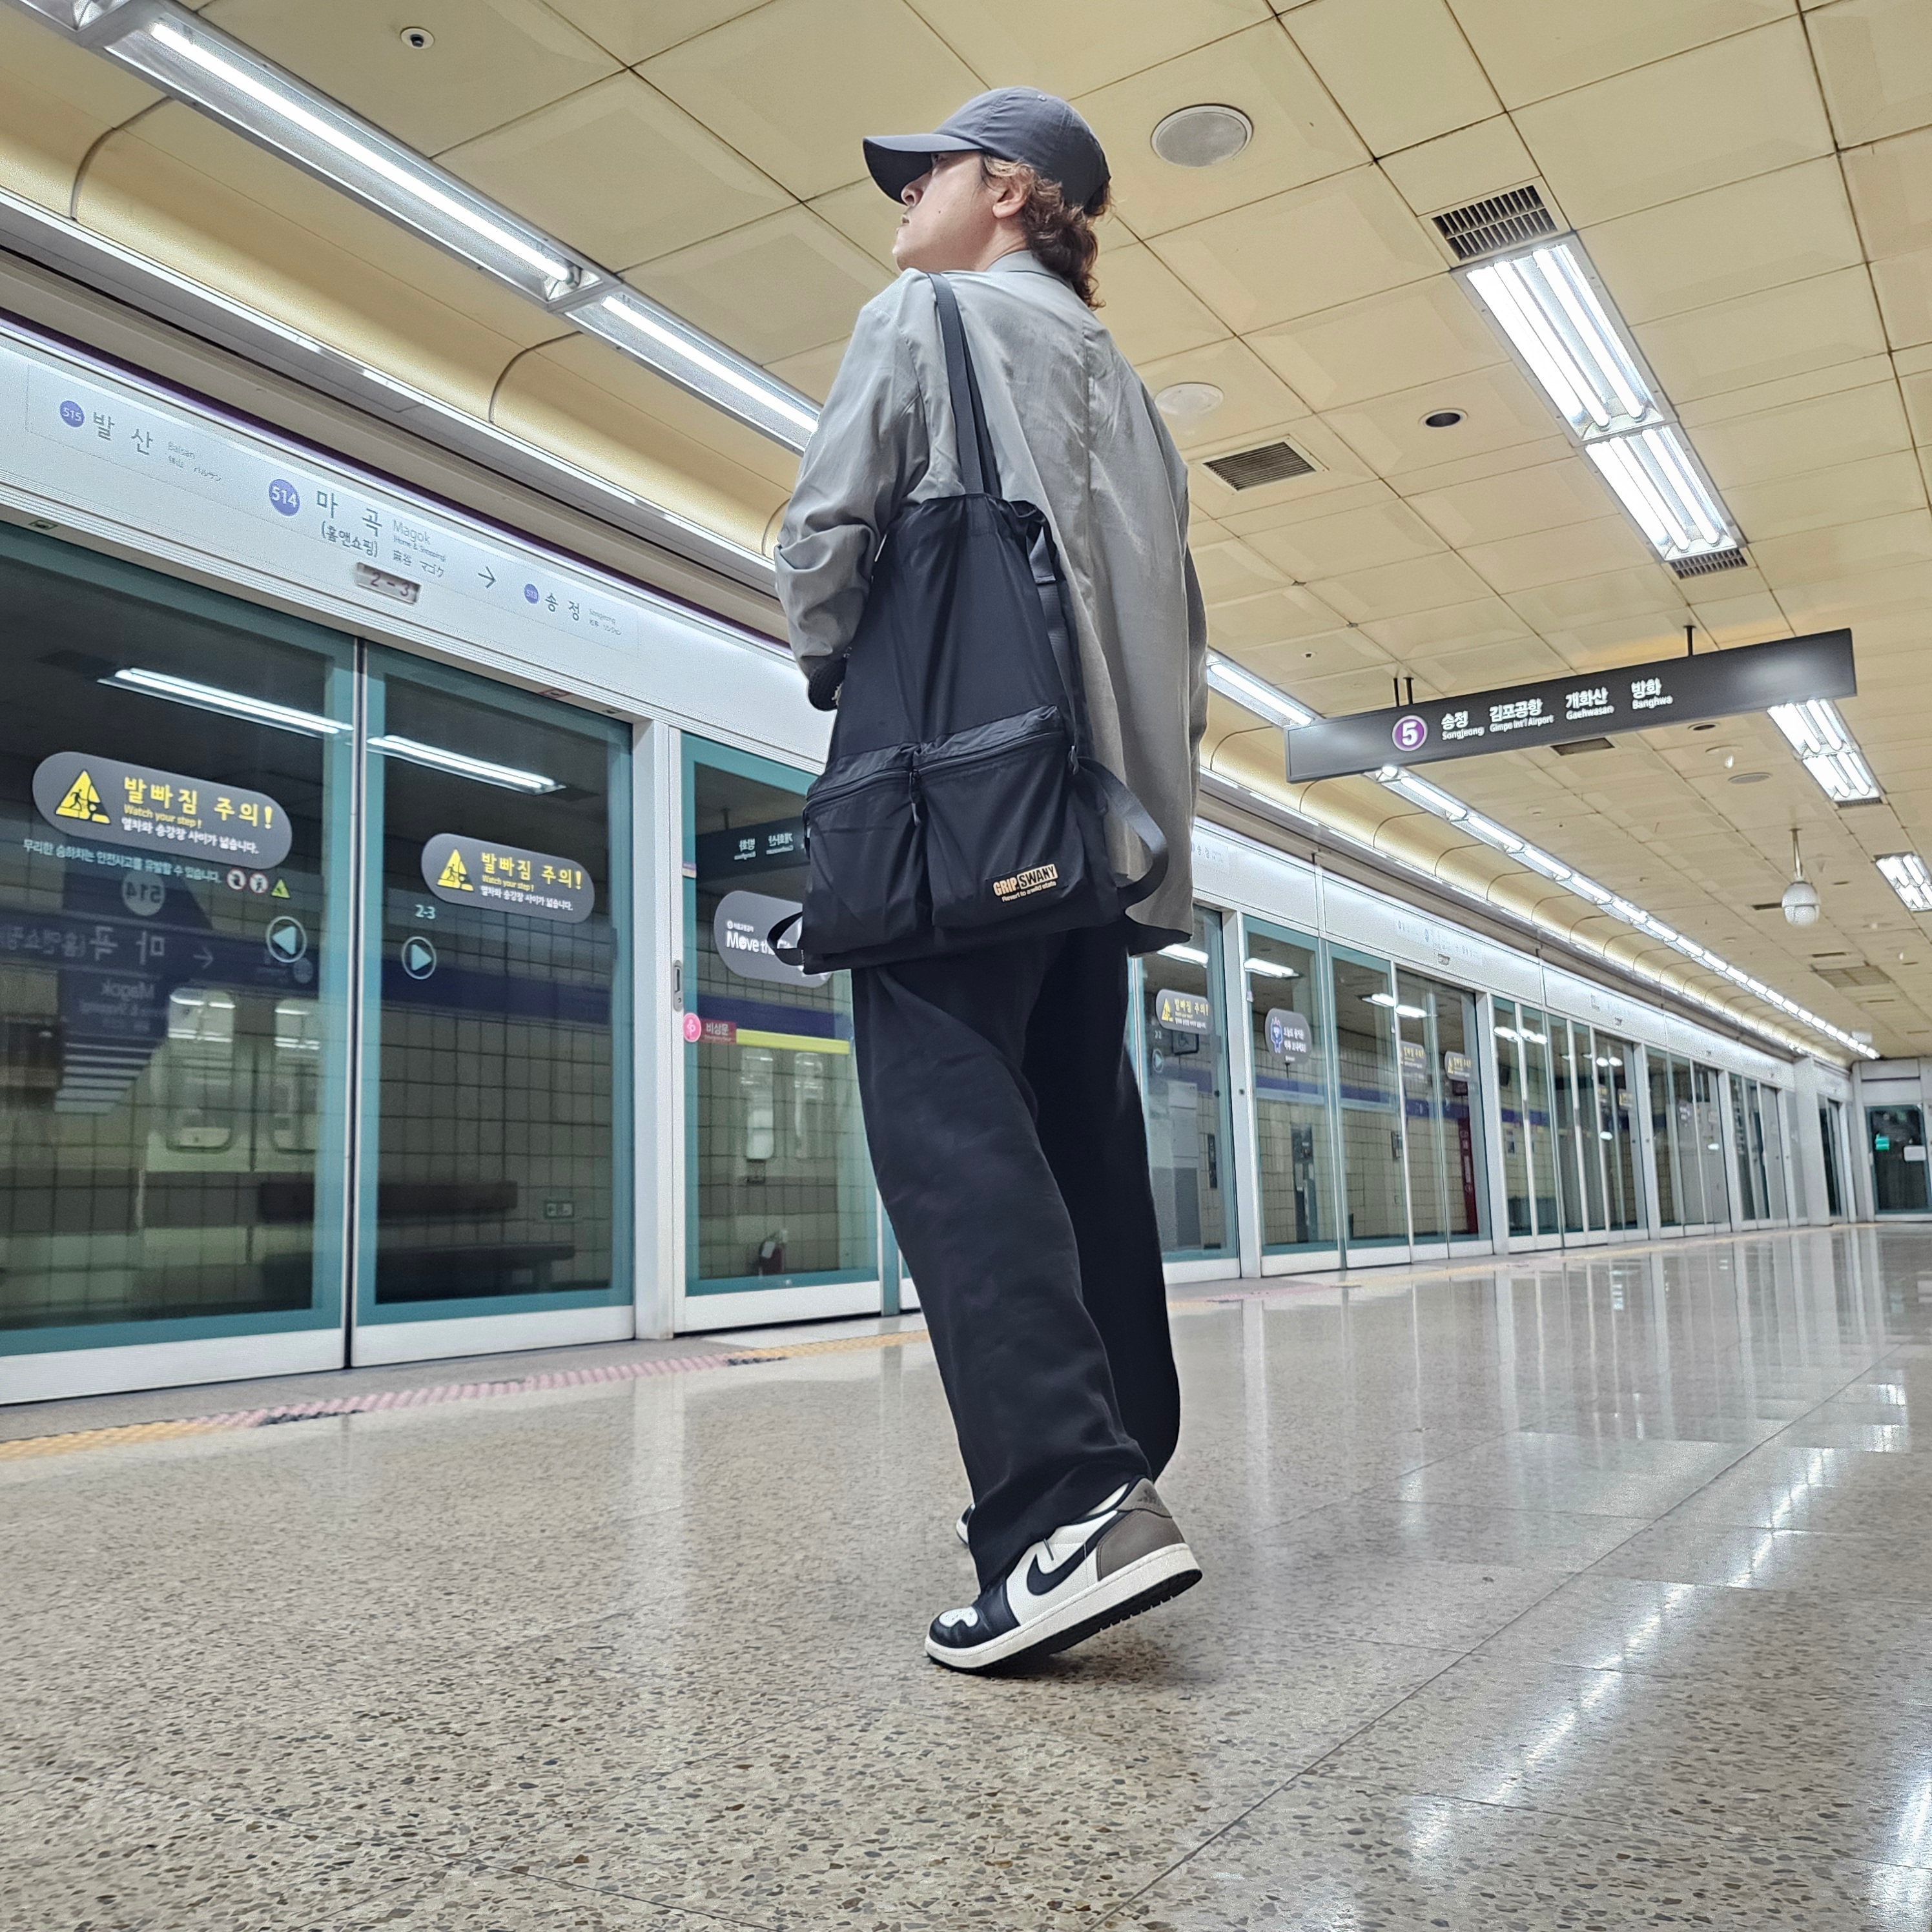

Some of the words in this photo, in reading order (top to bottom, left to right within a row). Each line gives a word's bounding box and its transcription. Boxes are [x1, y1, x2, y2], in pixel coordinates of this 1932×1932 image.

[63, 407, 81, 422] 515
[271, 486, 298, 508] 514
[393, 519, 431, 545] Magok
[1565, 686, 1608, 709] 개화산
[1631, 677, 1662, 699] 방화
[1489, 697, 1543, 722] 김포공항
[1566, 705, 1615, 721] Gaehwasan
[1632, 695, 1674, 710] Banghwa
[1441, 710, 1469, 730] 송정
[1489, 722, 1513, 732] Gimpo
[1528, 714, 1554, 726] Airport
[1402, 721, 1419, 746] 5
[1442, 726, 1485, 741] Songjeong
[123, 776, 198, 815] 발빠짐
[214, 796, 273, 830] 주의!
[123, 803, 154, 819] Watch
[154, 810, 176, 823] your
[121, 817, 154, 835] 열차와
[155, 823, 187, 841] 승강장
[188, 830, 218, 847] 사이가
[23, 838, 54, 856] 무리한
[173, 865, 183, 878] 수
[481, 852, 531, 881] 발빠짐
[541, 865, 582, 890] 주의!
[482, 874, 502, 885] Watch
[1018, 865, 1056, 888] SWANY
[503, 889, 524, 903] 승강장
[415, 904, 436, 920] 2-3
[726, 930, 759, 952] Move
[706, 1023, 729, 1036] 비상문
